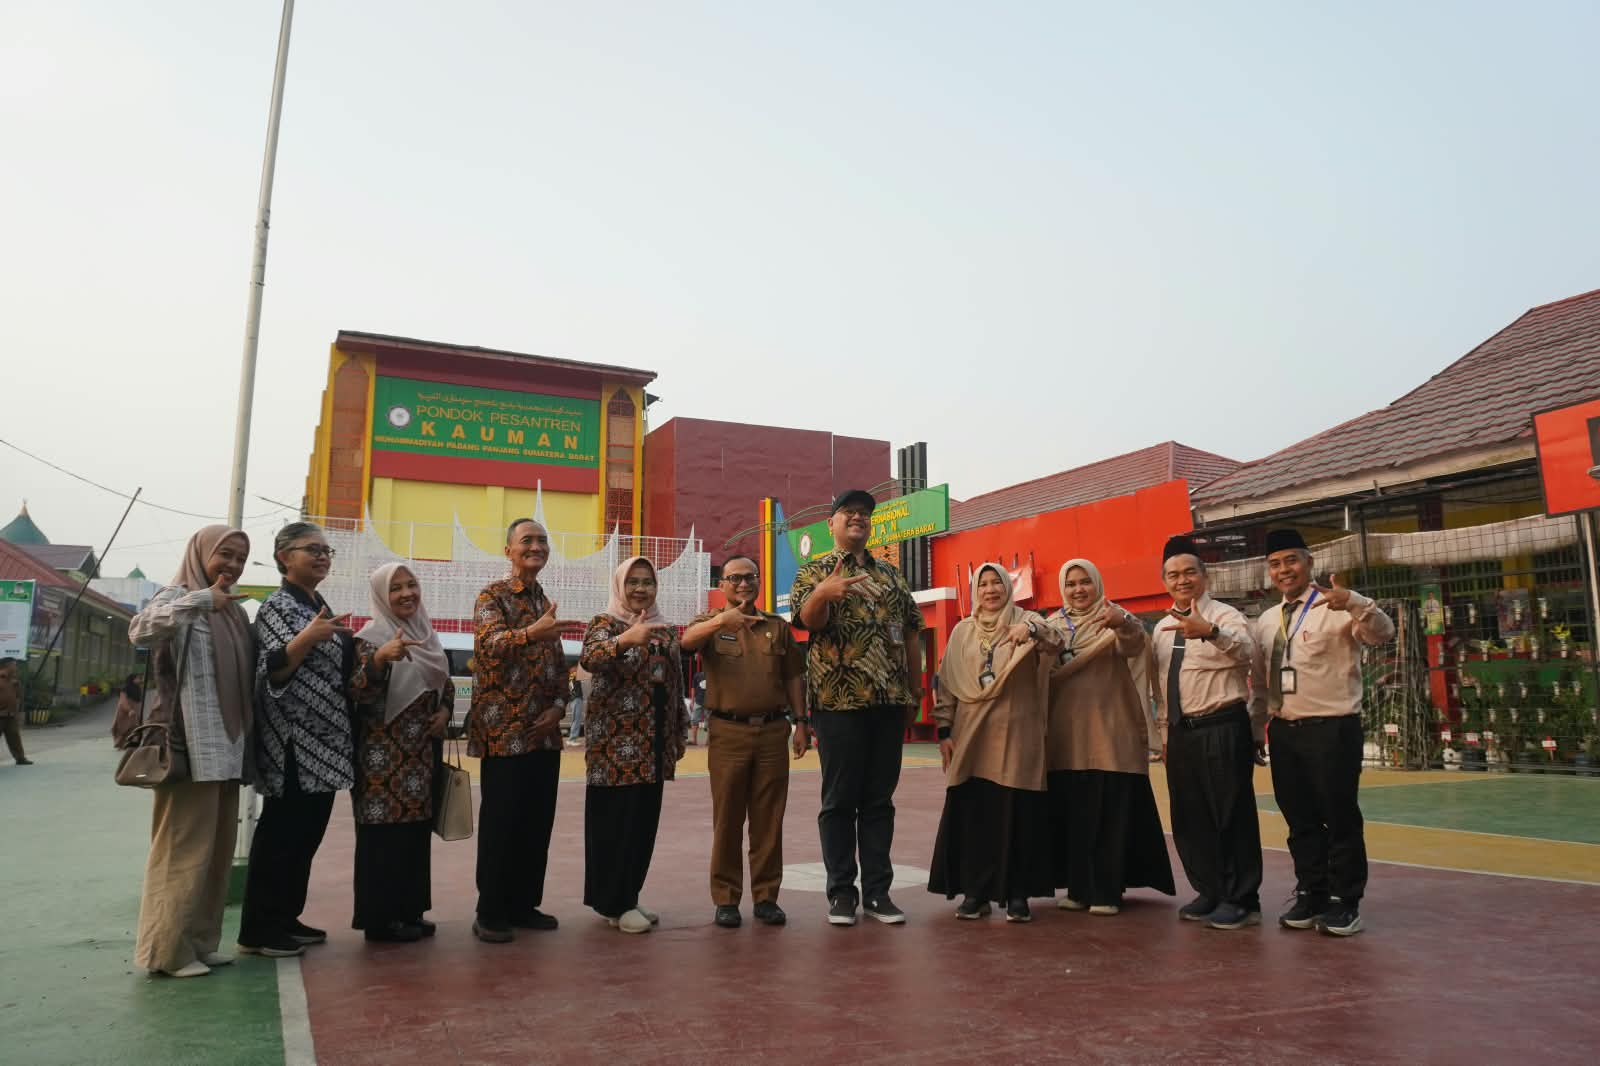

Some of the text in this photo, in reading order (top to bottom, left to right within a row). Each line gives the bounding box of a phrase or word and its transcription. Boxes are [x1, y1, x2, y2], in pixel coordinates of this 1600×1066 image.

[416, 405, 581, 433] PONDOK PESANTREN
[421, 421, 578, 450] KAUMAN
[523, 449, 565, 459] SUMATERA
[871, 506, 909, 526] ERNASIONAL
